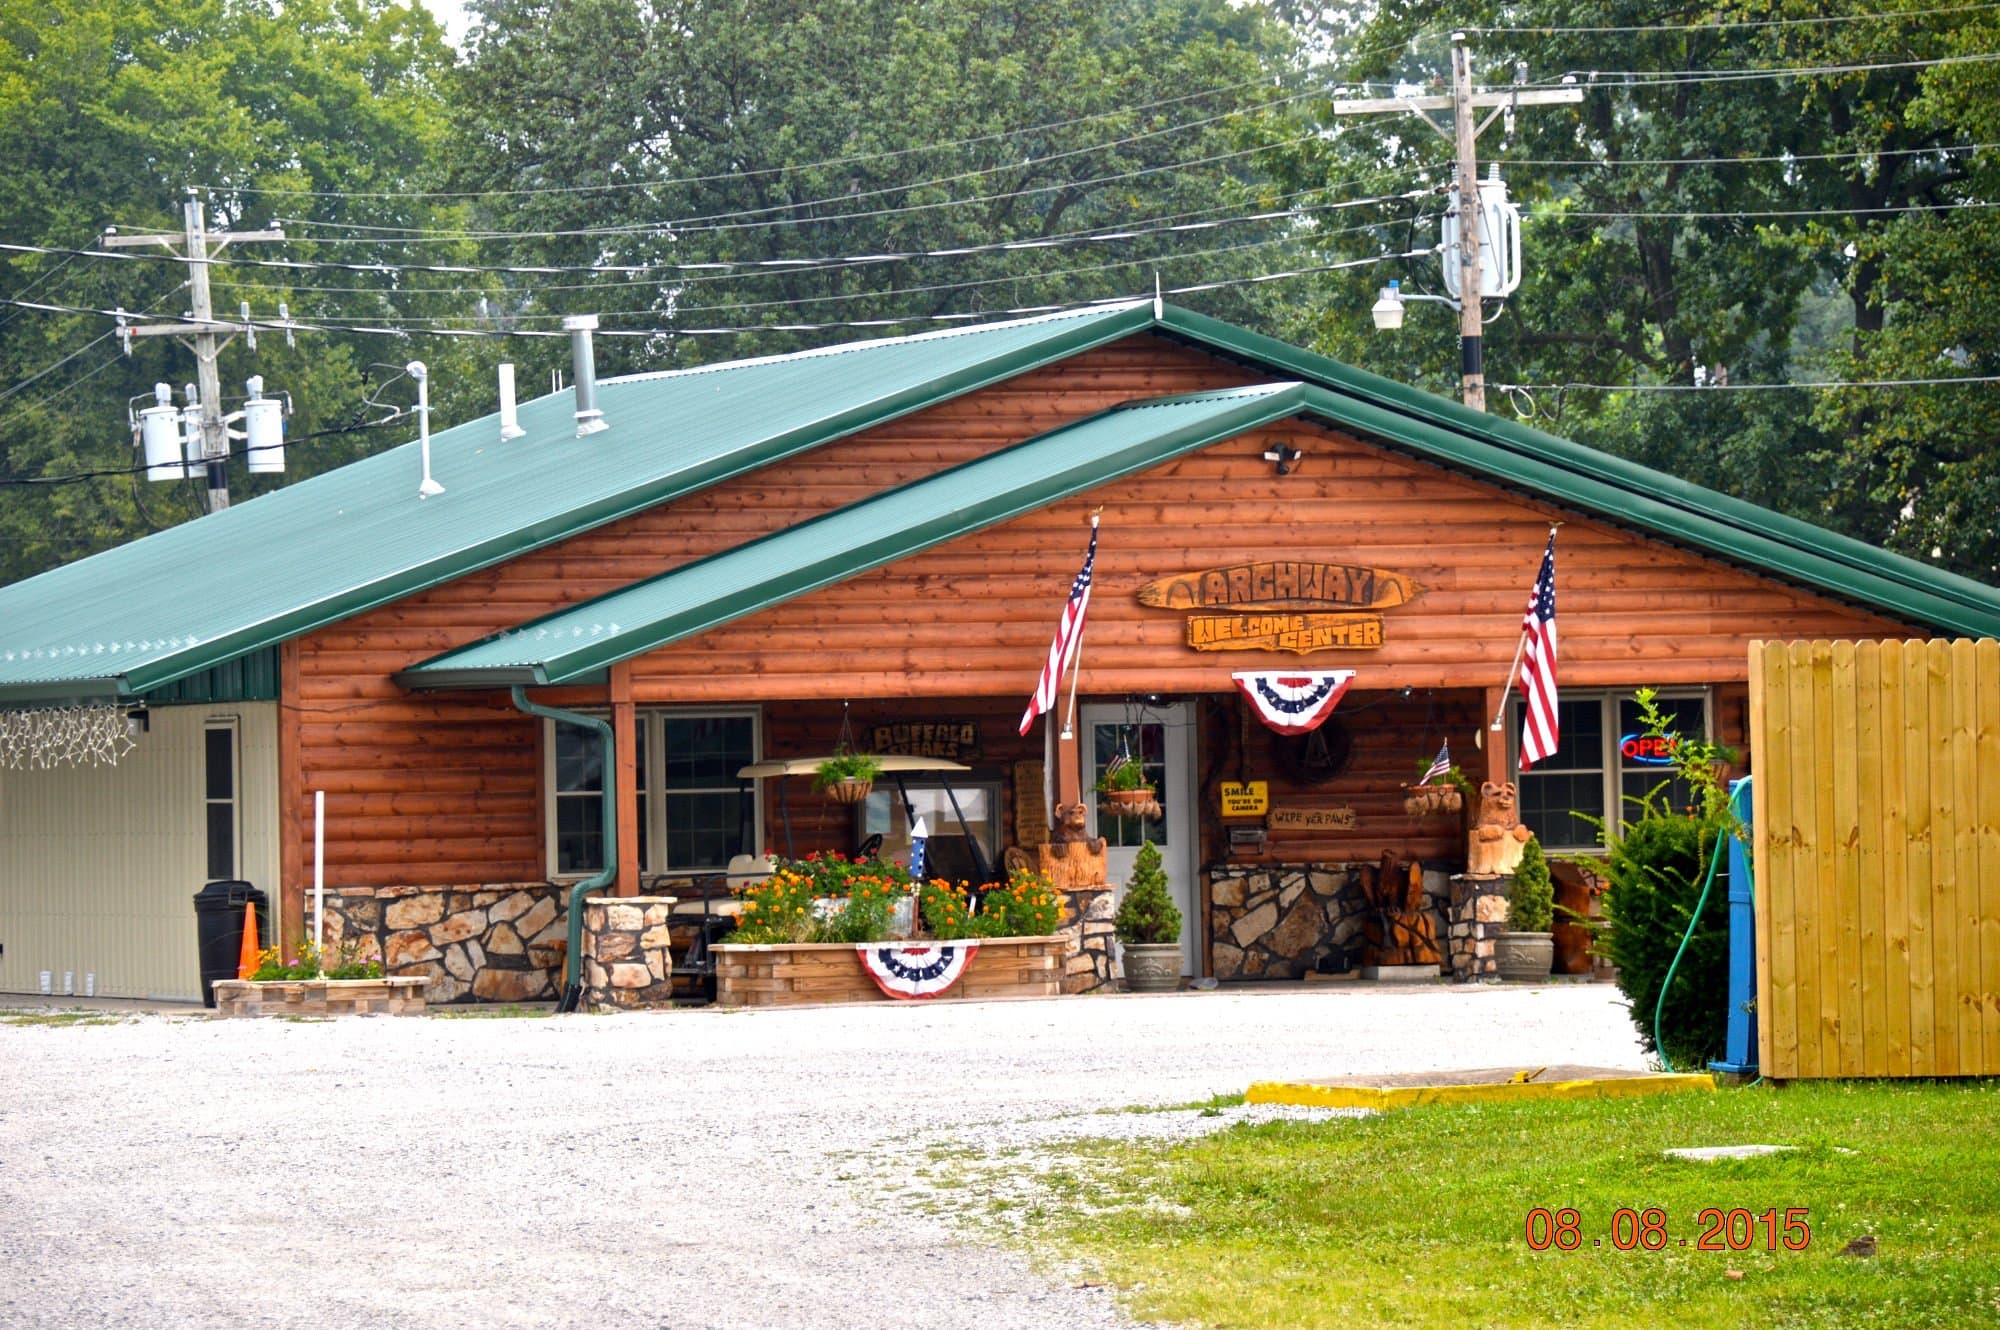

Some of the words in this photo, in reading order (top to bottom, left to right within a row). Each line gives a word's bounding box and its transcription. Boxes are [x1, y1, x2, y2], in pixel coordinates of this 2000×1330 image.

[1203, 562, 1373, 605] ARCHWAY
[1193, 615, 1305, 644] WELCOME
[1279, 621, 1382, 649] CENTER
[874, 723, 974, 751] BUFFALO
[1223, 787, 1254, 797] SMILE
[1274, 811, 1302, 824] WIPE
[1324, 812, 1353, 825] PAWS
